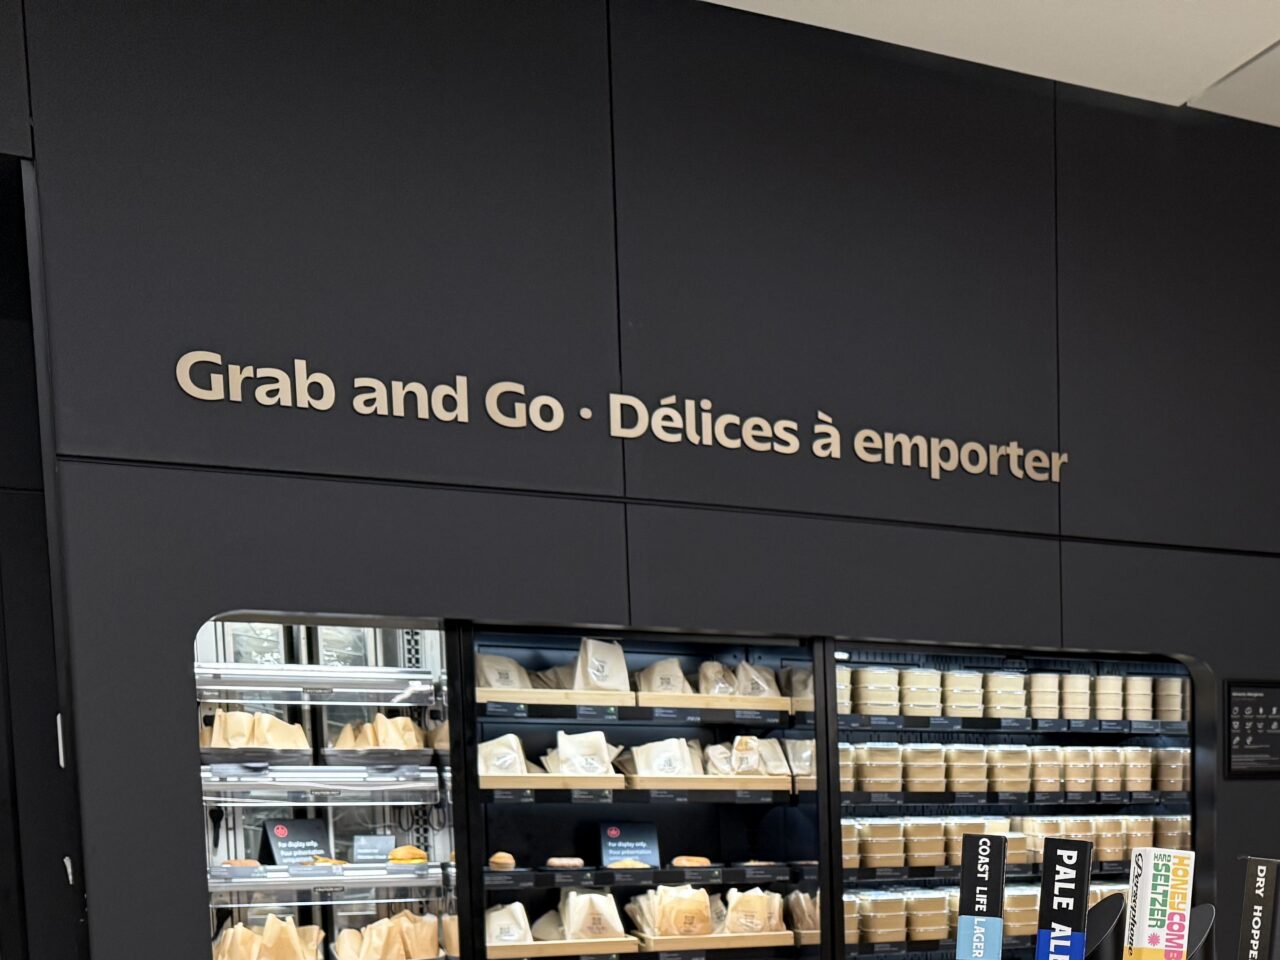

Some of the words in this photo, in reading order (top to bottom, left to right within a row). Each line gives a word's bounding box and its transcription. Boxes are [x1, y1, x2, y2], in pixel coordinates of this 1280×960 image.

[175, 350, 335, 411] Grab
[352, 375, 469, 423] and
[485, 381, 564, 432] Go
[609, 393, 800, 455] Délices
[812, 410, 840, 459] à
[853, 428, 1068, 482] emporter
[977, 838, 991, 881] COAST
[1154, 853, 1171, 862] HARD
[975, 887, 989, 912] LIFE
[1053, 849, 1077, 911] PALE
[1148, 863, 1171, 929] SELTZER
[1256, 865, 1267, 897] DRY
[972, 917, 986, 958] LAGER
